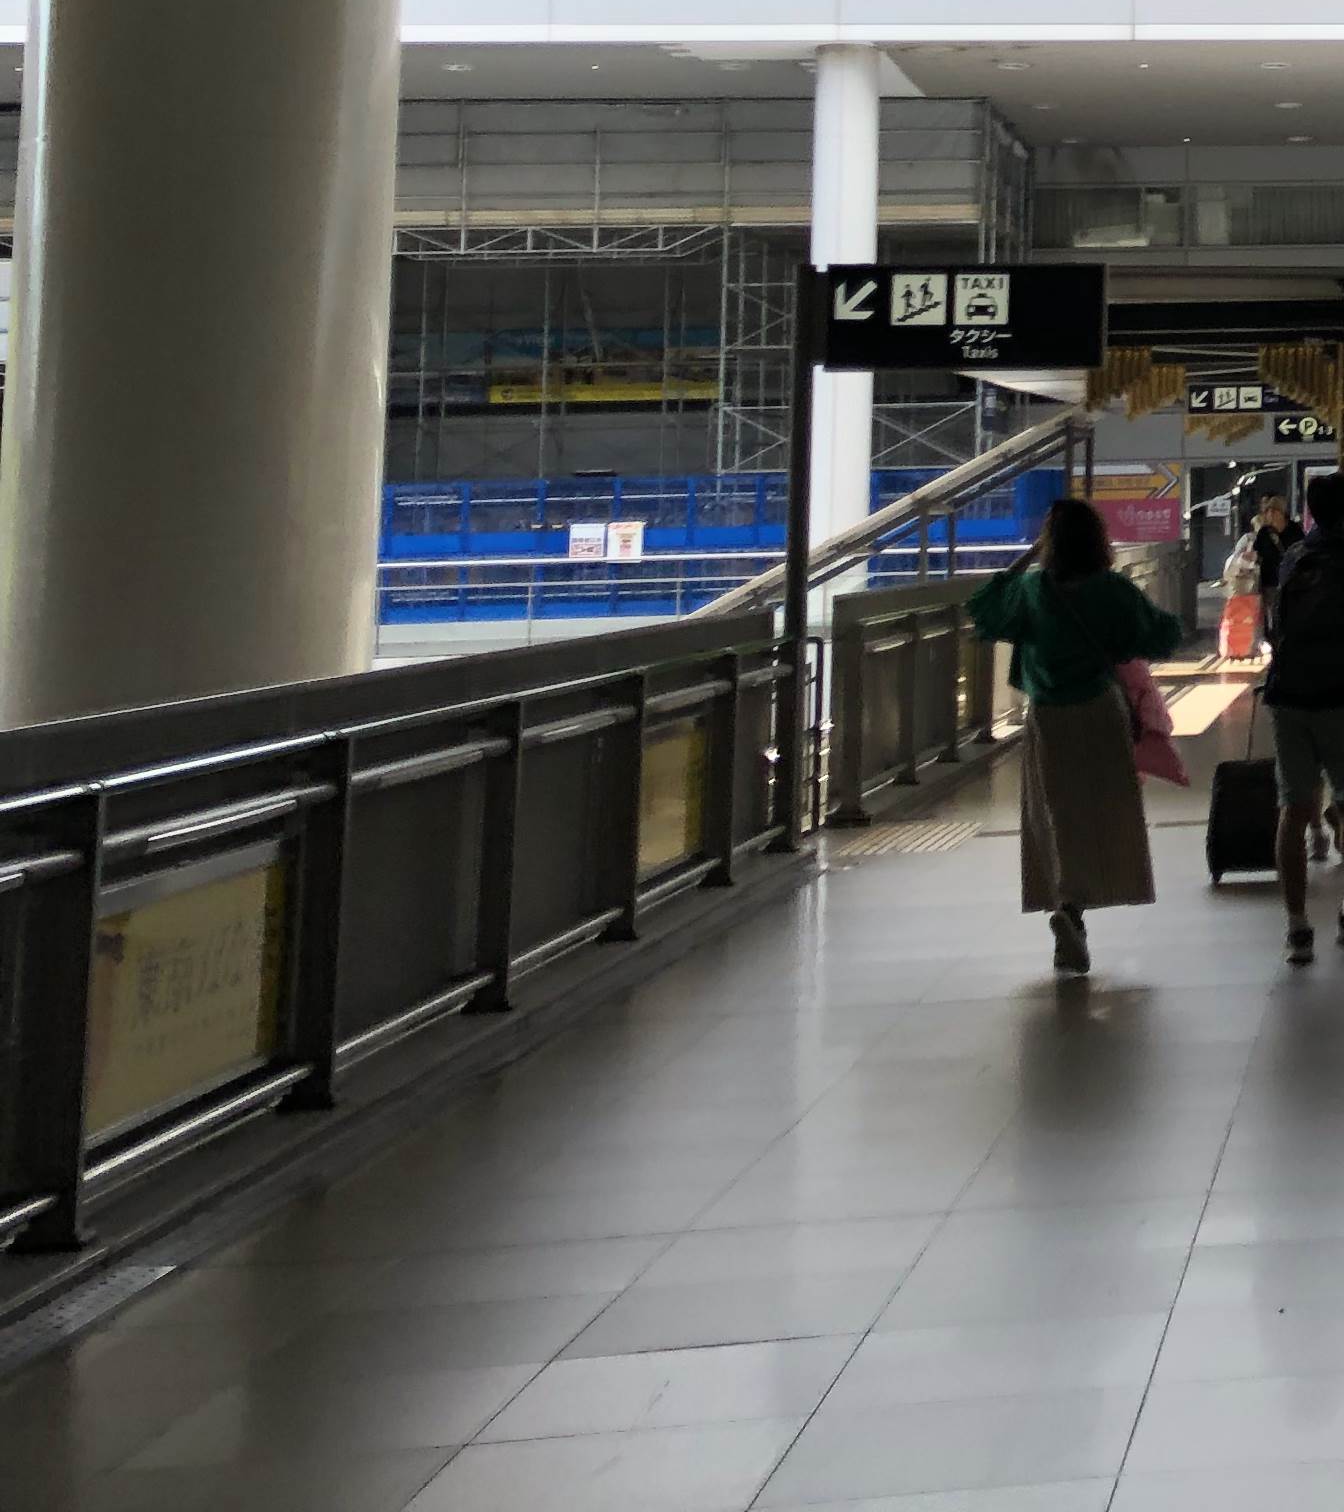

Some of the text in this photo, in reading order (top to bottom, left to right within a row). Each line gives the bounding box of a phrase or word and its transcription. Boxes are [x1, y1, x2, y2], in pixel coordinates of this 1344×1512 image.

[960, 277, 1004, 289] TAXI
[950, 329, 1013, 345] タクシー
